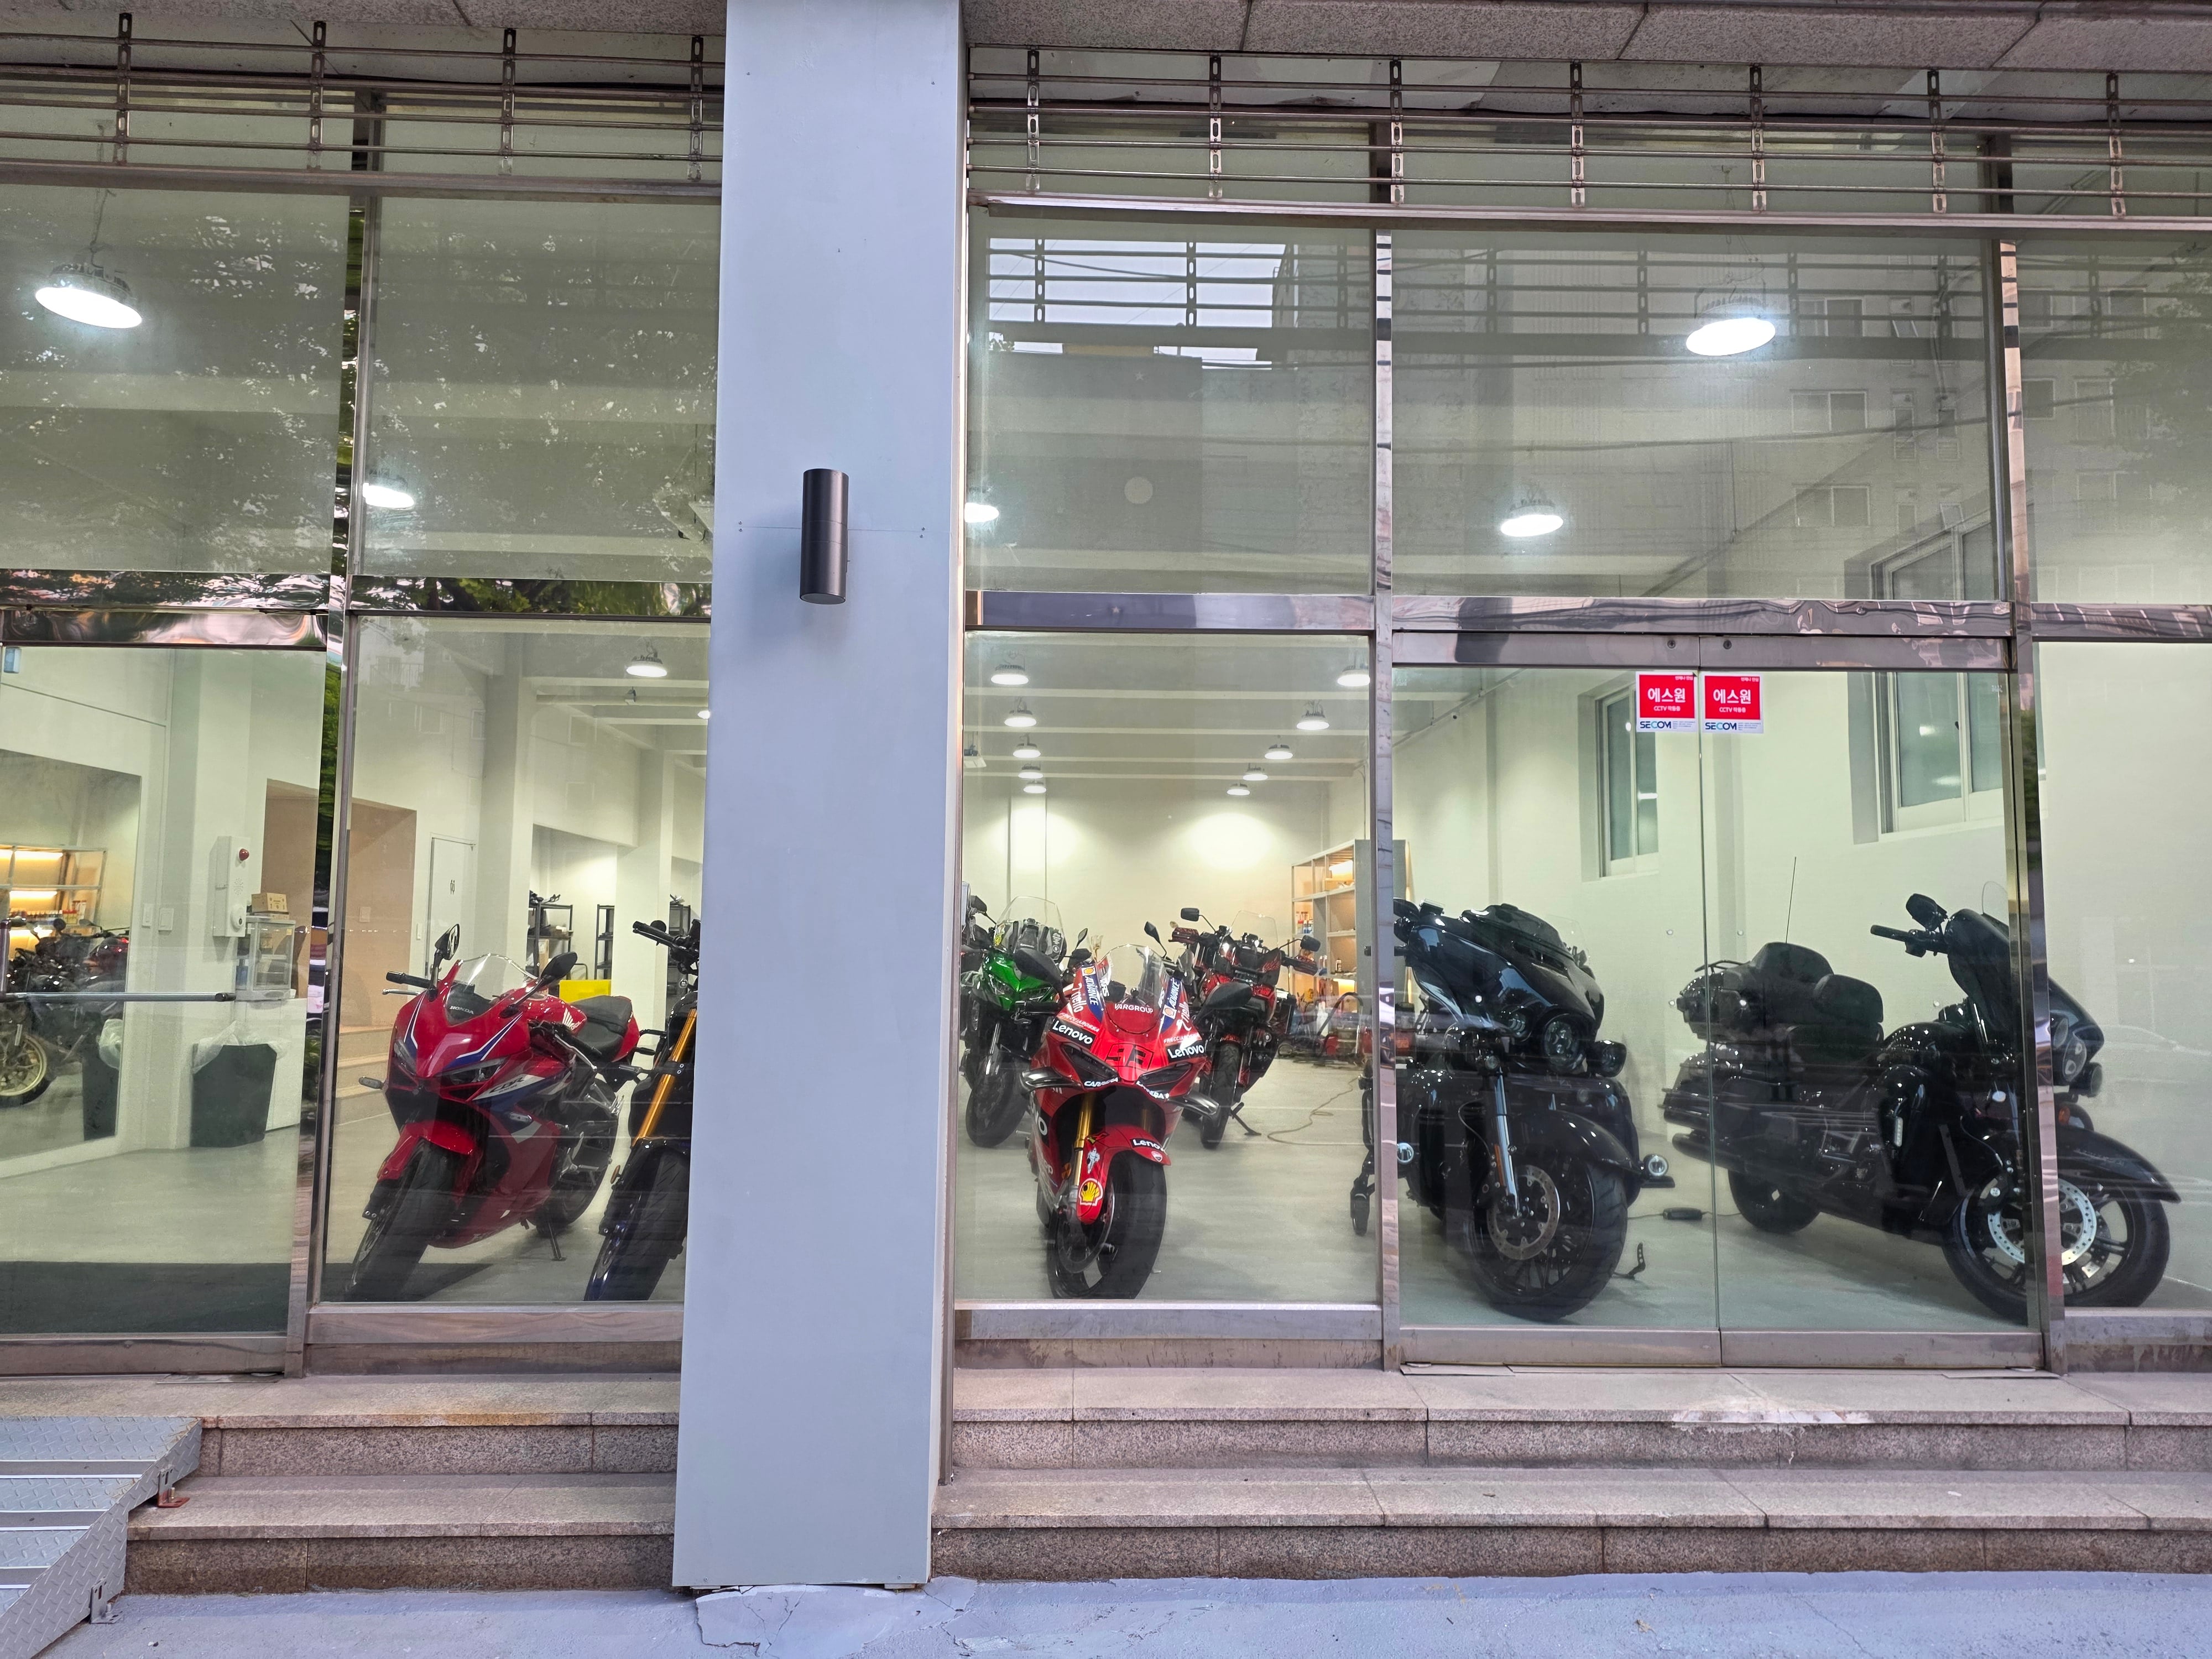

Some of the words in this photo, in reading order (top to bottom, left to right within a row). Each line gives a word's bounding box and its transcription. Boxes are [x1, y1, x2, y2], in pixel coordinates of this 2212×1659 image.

[1647, 687, 1686, 703] 에스원
[1713, 688, 1751, 704] 에스원
[1640, 721, 1672, 729] SECOM
[1084, 975, 1099, 1006] ADVANCE
[1168, 980, 1180, 1009] ADVANCE
[449, 1005, 474, 1015] HONDA
[1052, 1020, 1093, 1045] Lenovo
[1167, 1044, 1204, 1058] Lenovo
[489, 1076, 525, 1093] CBR
